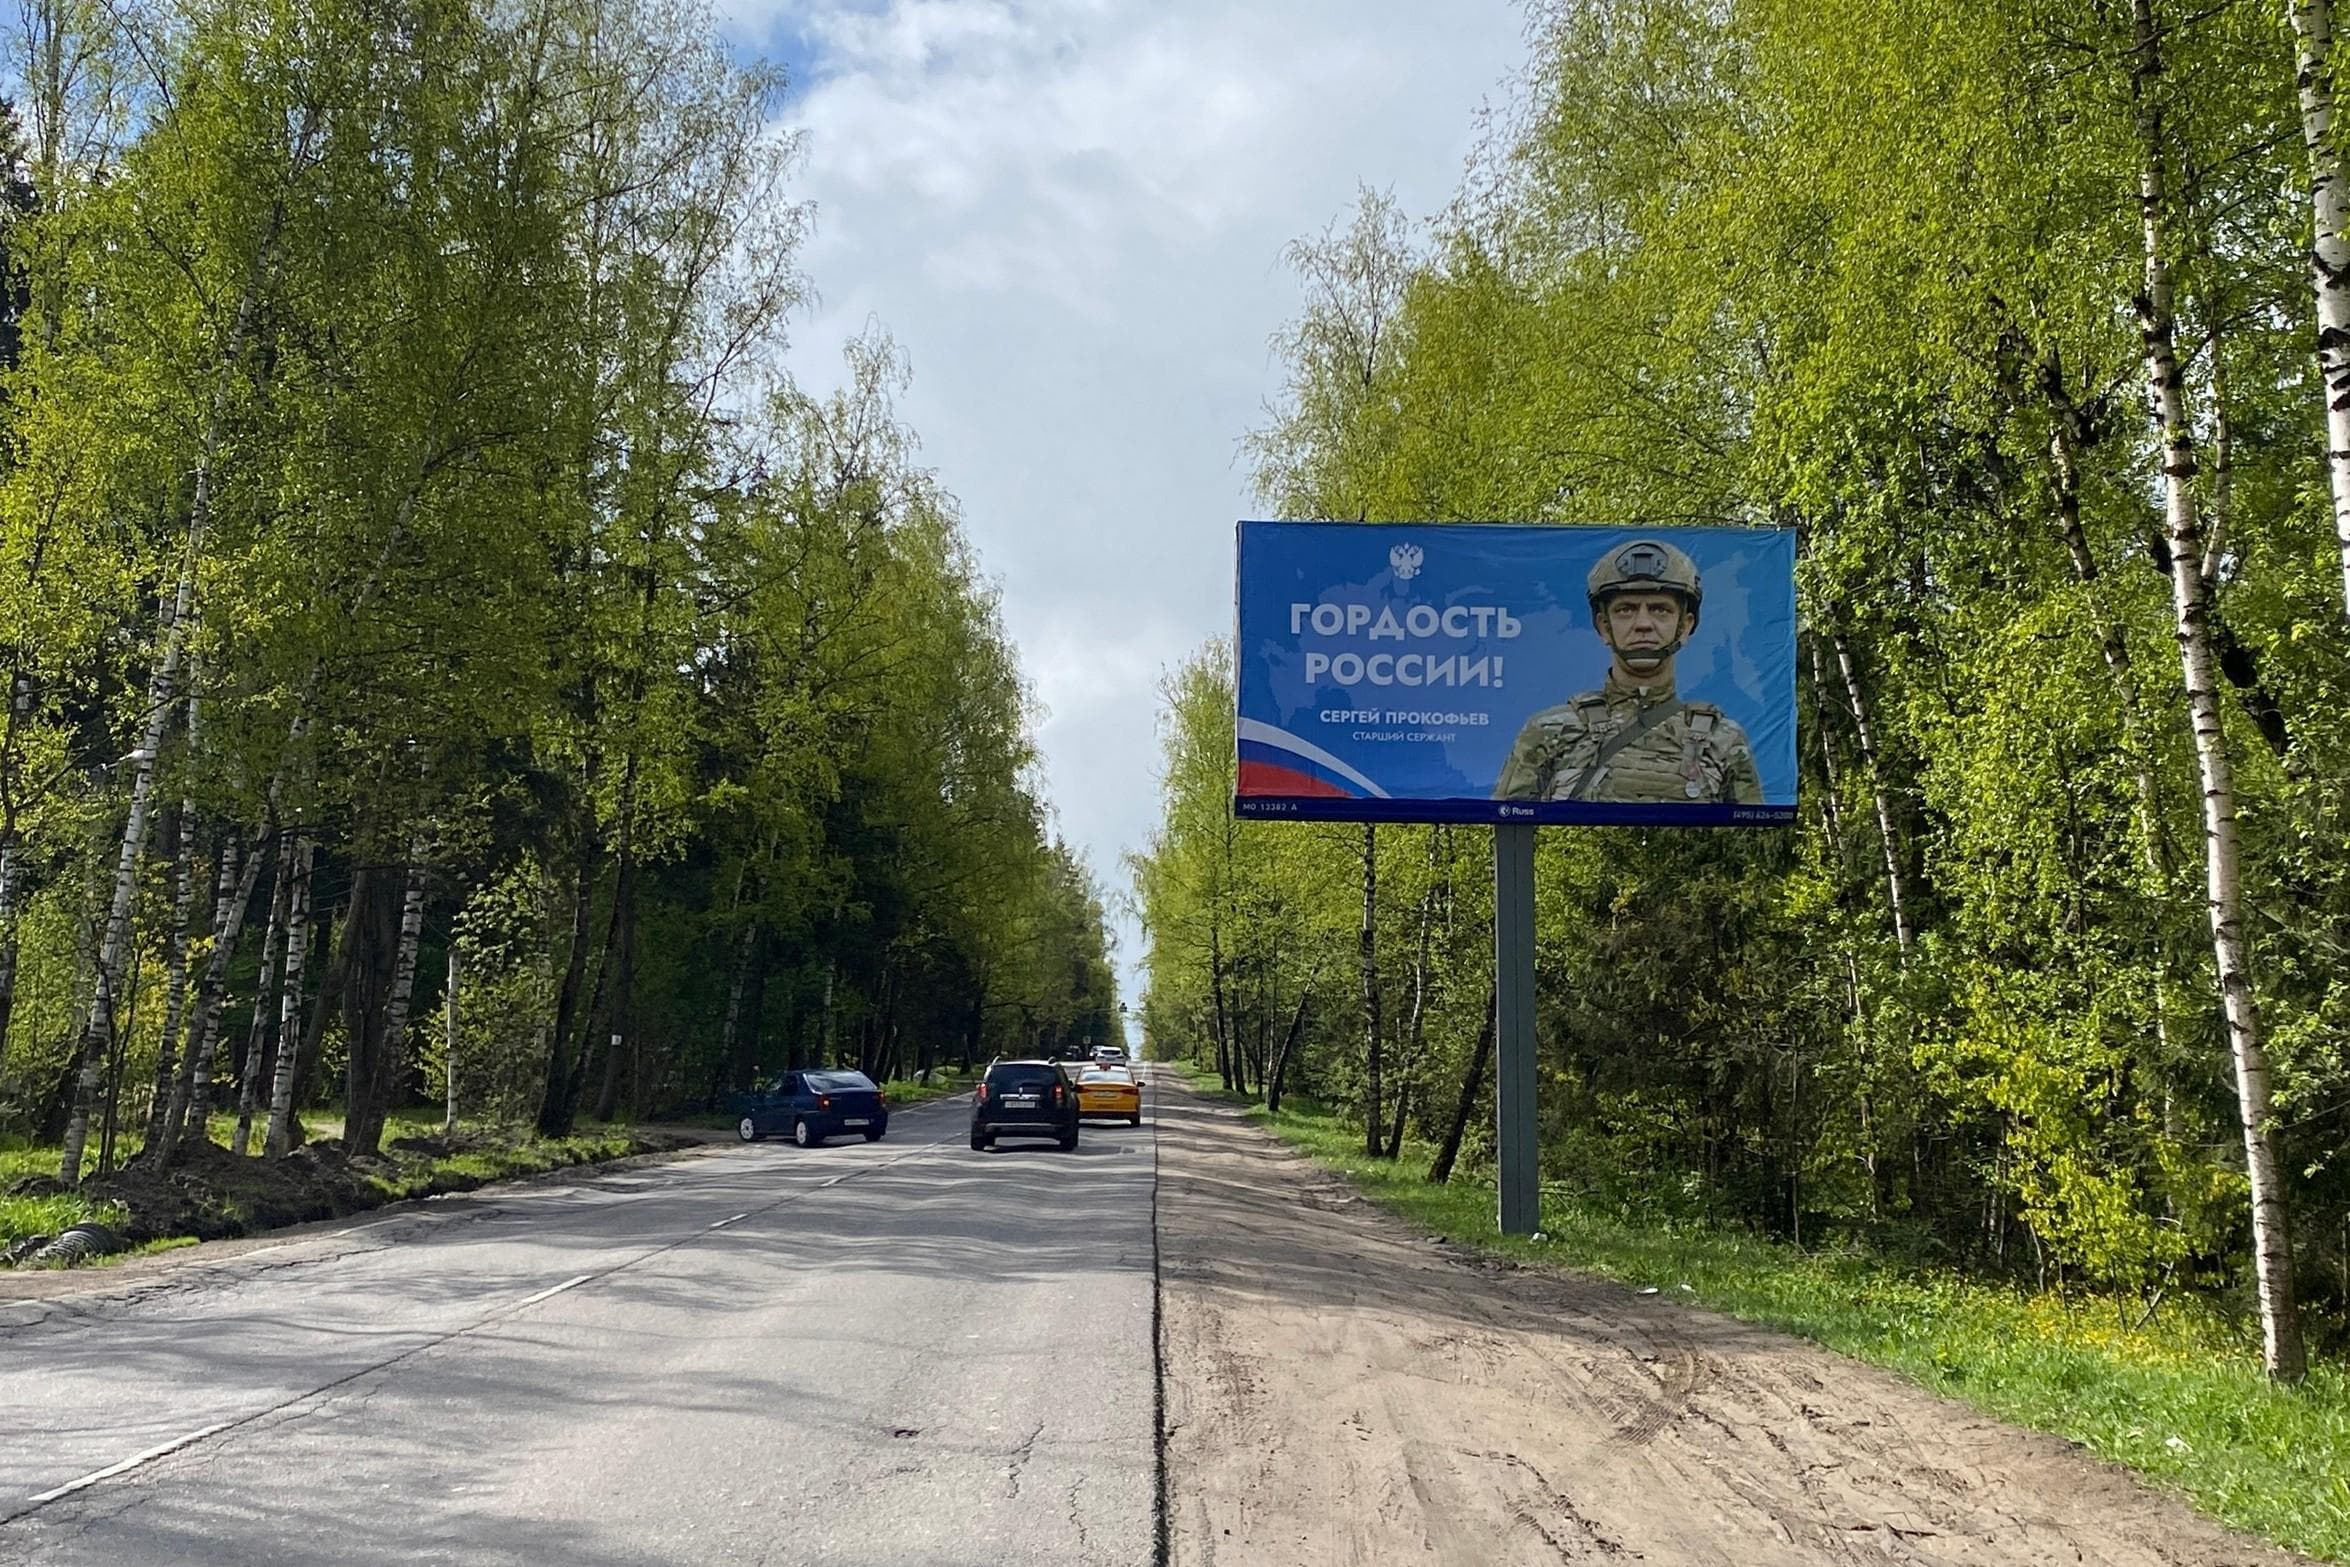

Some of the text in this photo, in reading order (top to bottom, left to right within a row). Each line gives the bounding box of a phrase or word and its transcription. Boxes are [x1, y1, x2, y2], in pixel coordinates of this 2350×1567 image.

[1290, 603, 1522, 641] ГОРДОСТЬ
[1305, 652, 1504, 688] РОССИИ!
[1320, 708, 1489, 726] СЕРГЕЙ ПРОКОФЬЕВ
[1352, 731, 1456, 742] СТАРШИЙ СЕРЖАНТ
